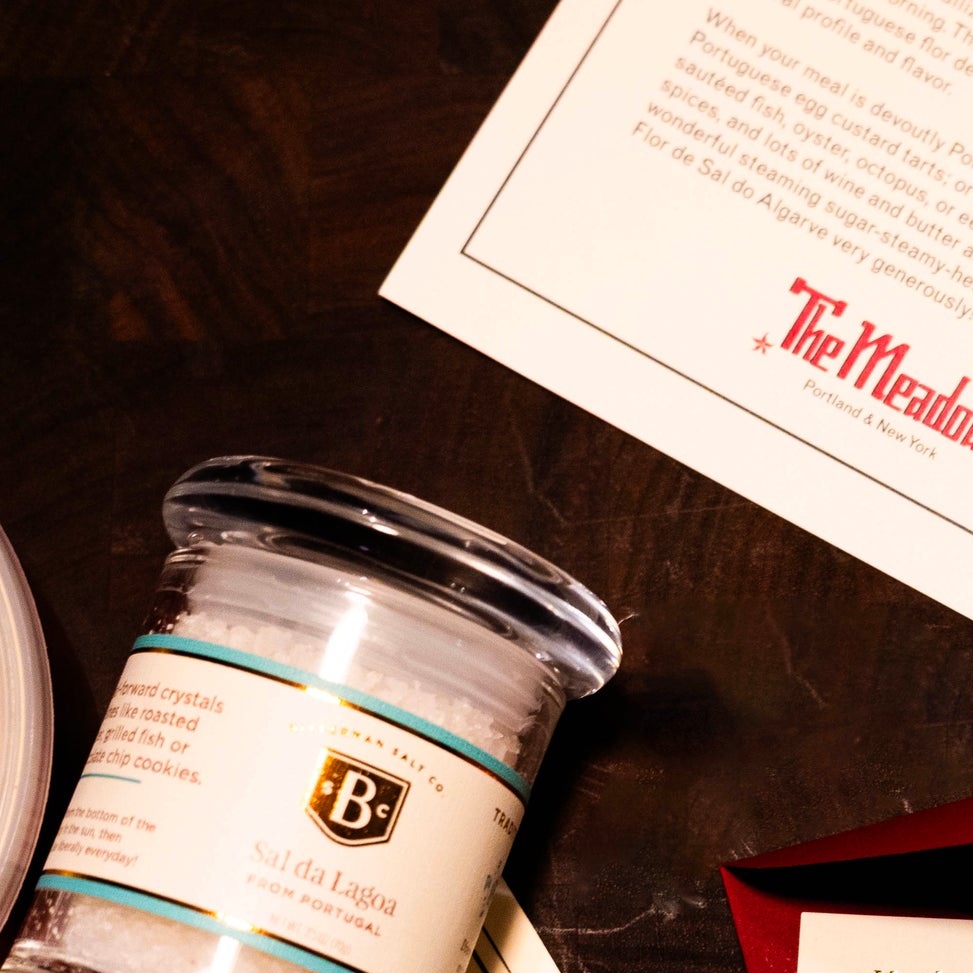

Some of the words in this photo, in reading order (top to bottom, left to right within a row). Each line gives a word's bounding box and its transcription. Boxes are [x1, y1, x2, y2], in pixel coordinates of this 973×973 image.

[706, 7, 757, 47] When
[758, 43, 799, 69] your
[801, 66, 849, 95] meal
[850, 88, 866, 107] is
[870, 102, 945, 152] devoutly
[919, 36, 950, 60] flor
[689, 28, 791, 96] Portuguese
[793, 91, 828, 119] egg
[831, 112, 901, 156] custard
[954, 179, 973, 195] or
[646, 101, 738, 158] wonderful
[738, 153, 822, 208] steaming
[660, 79, 719, 122] spices,
[725, 115, 763, 141] and
[763, 132, 798, 161] lots
[801, 157, 823, 173] of
[824, 169, 866, 198] wine
[867, 192, 905, 218] and
[904, 209, 961, 249] butter
[750, 94, 785, 129] fish,
[793, 121, 850, 163] oyster,
[855, 156, 928, 206] octopus,
[935, 200, 955, 215] or
[631, 120, 669, 149] Flor
[671, 146, 694, 165] de
[697, 156, 730, 184] Sal
[731, 178, 754, 198] do
[756, 192, 828, 239] Algarve
[832, 235, 870, 264] very
[779, 276, 848, 373] The
[802, 379, 863, 419] Portland
[862, 413, 874, 426] &
[875, 419, 907, 443] New
[908, 436, 937, 460] York
[120, 703, 138, 717] like
[139, 708, 198, 731] roasted
[160, 687, 223, 713] crystals
[105, 727, 138, 743] grilled
[139, 729, 165, 747] fish
[170, 741, 190, 753] or
[106, 749, 130, 767] chip
[133, 756, 201, 784] cookies.
[392, 747, 425, 772] SALT
[86, 808, 117, 821] bottom
[121, 816, 134, 826] of
[137, 819, 156, 831] the
[99, 828, 121, 841] then
[247, 875, 294, 897] FROM
[300, 897, 381, 935] PORTUGAL
[252, 841, 290, 870] Sal
[294, 858, 325, 885] da
[329, 871, 396, 916] Lagoa
